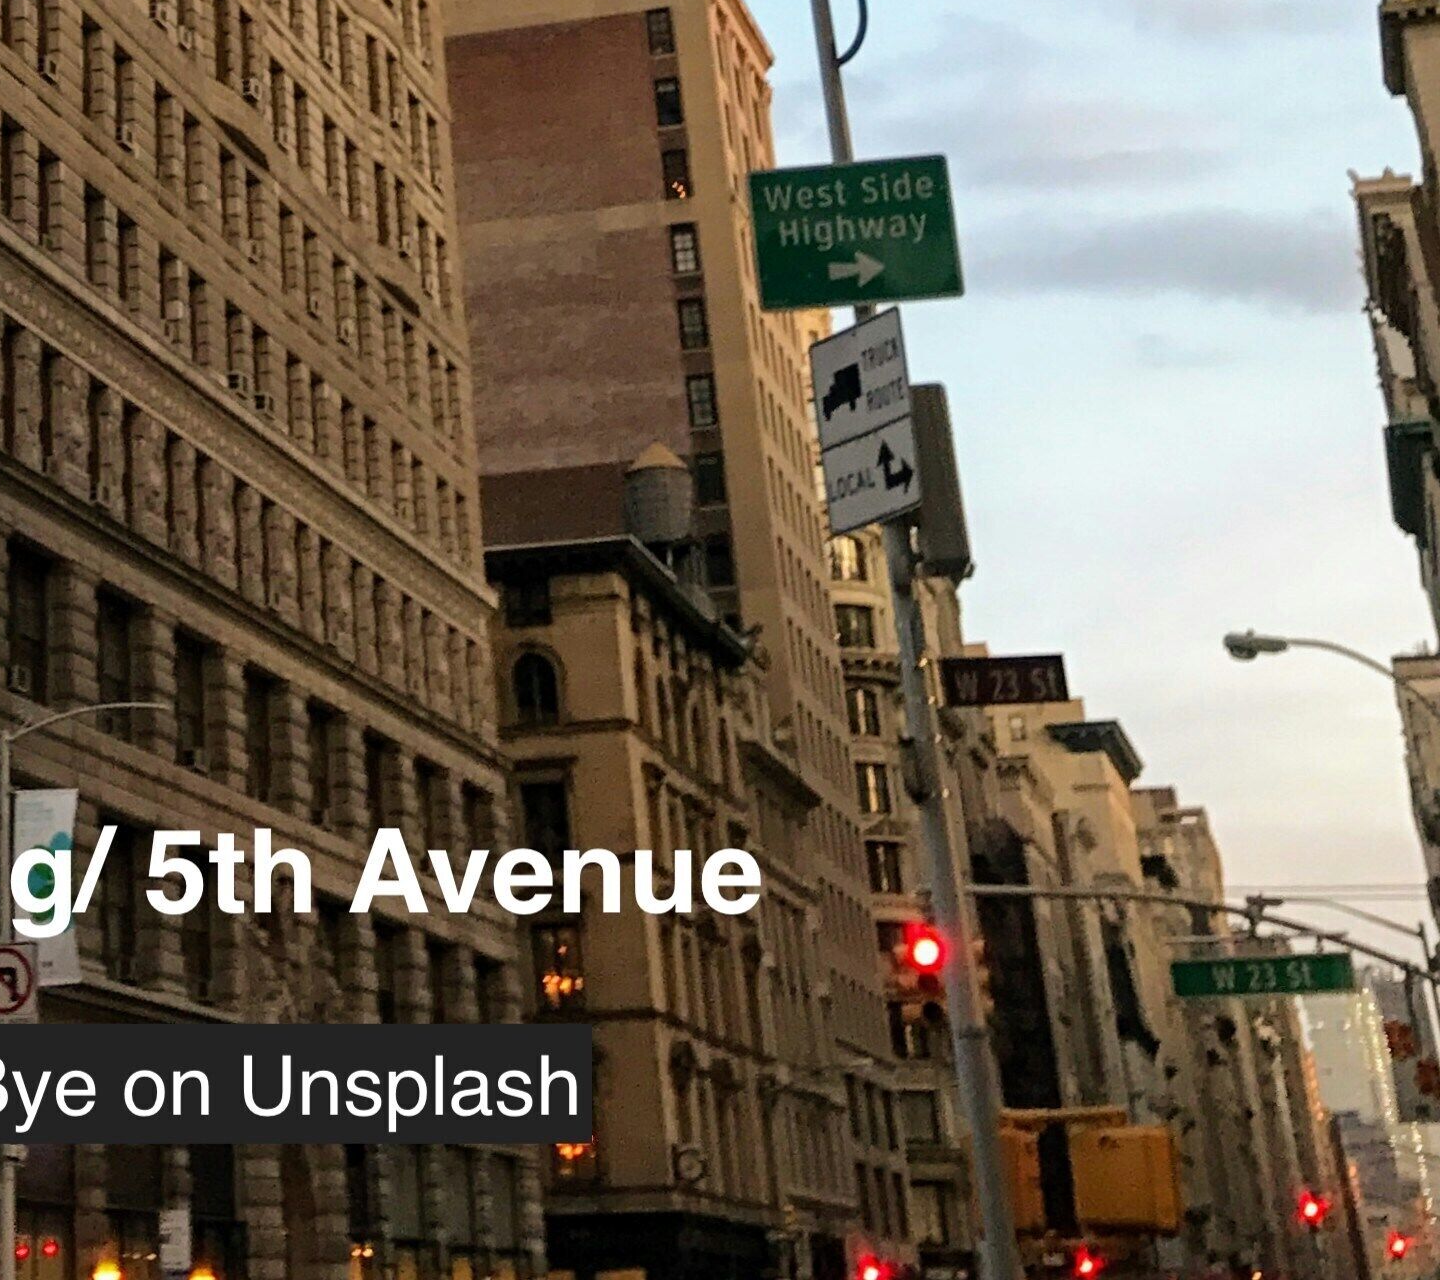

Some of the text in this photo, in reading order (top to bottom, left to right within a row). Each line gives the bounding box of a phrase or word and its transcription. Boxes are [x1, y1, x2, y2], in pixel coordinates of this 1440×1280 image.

[764, 172, 934, 212] West Side
[779, 213, 928, 252] Highway
[862, 337, 900, 372] TRUCK
[866, 376, 905, 411] ROUTE
[827, 463, 876, 503] LOCAL
[954, 663, 1059, 701] W 23 St
[1211, 960, 1311, 989] W 23 St
